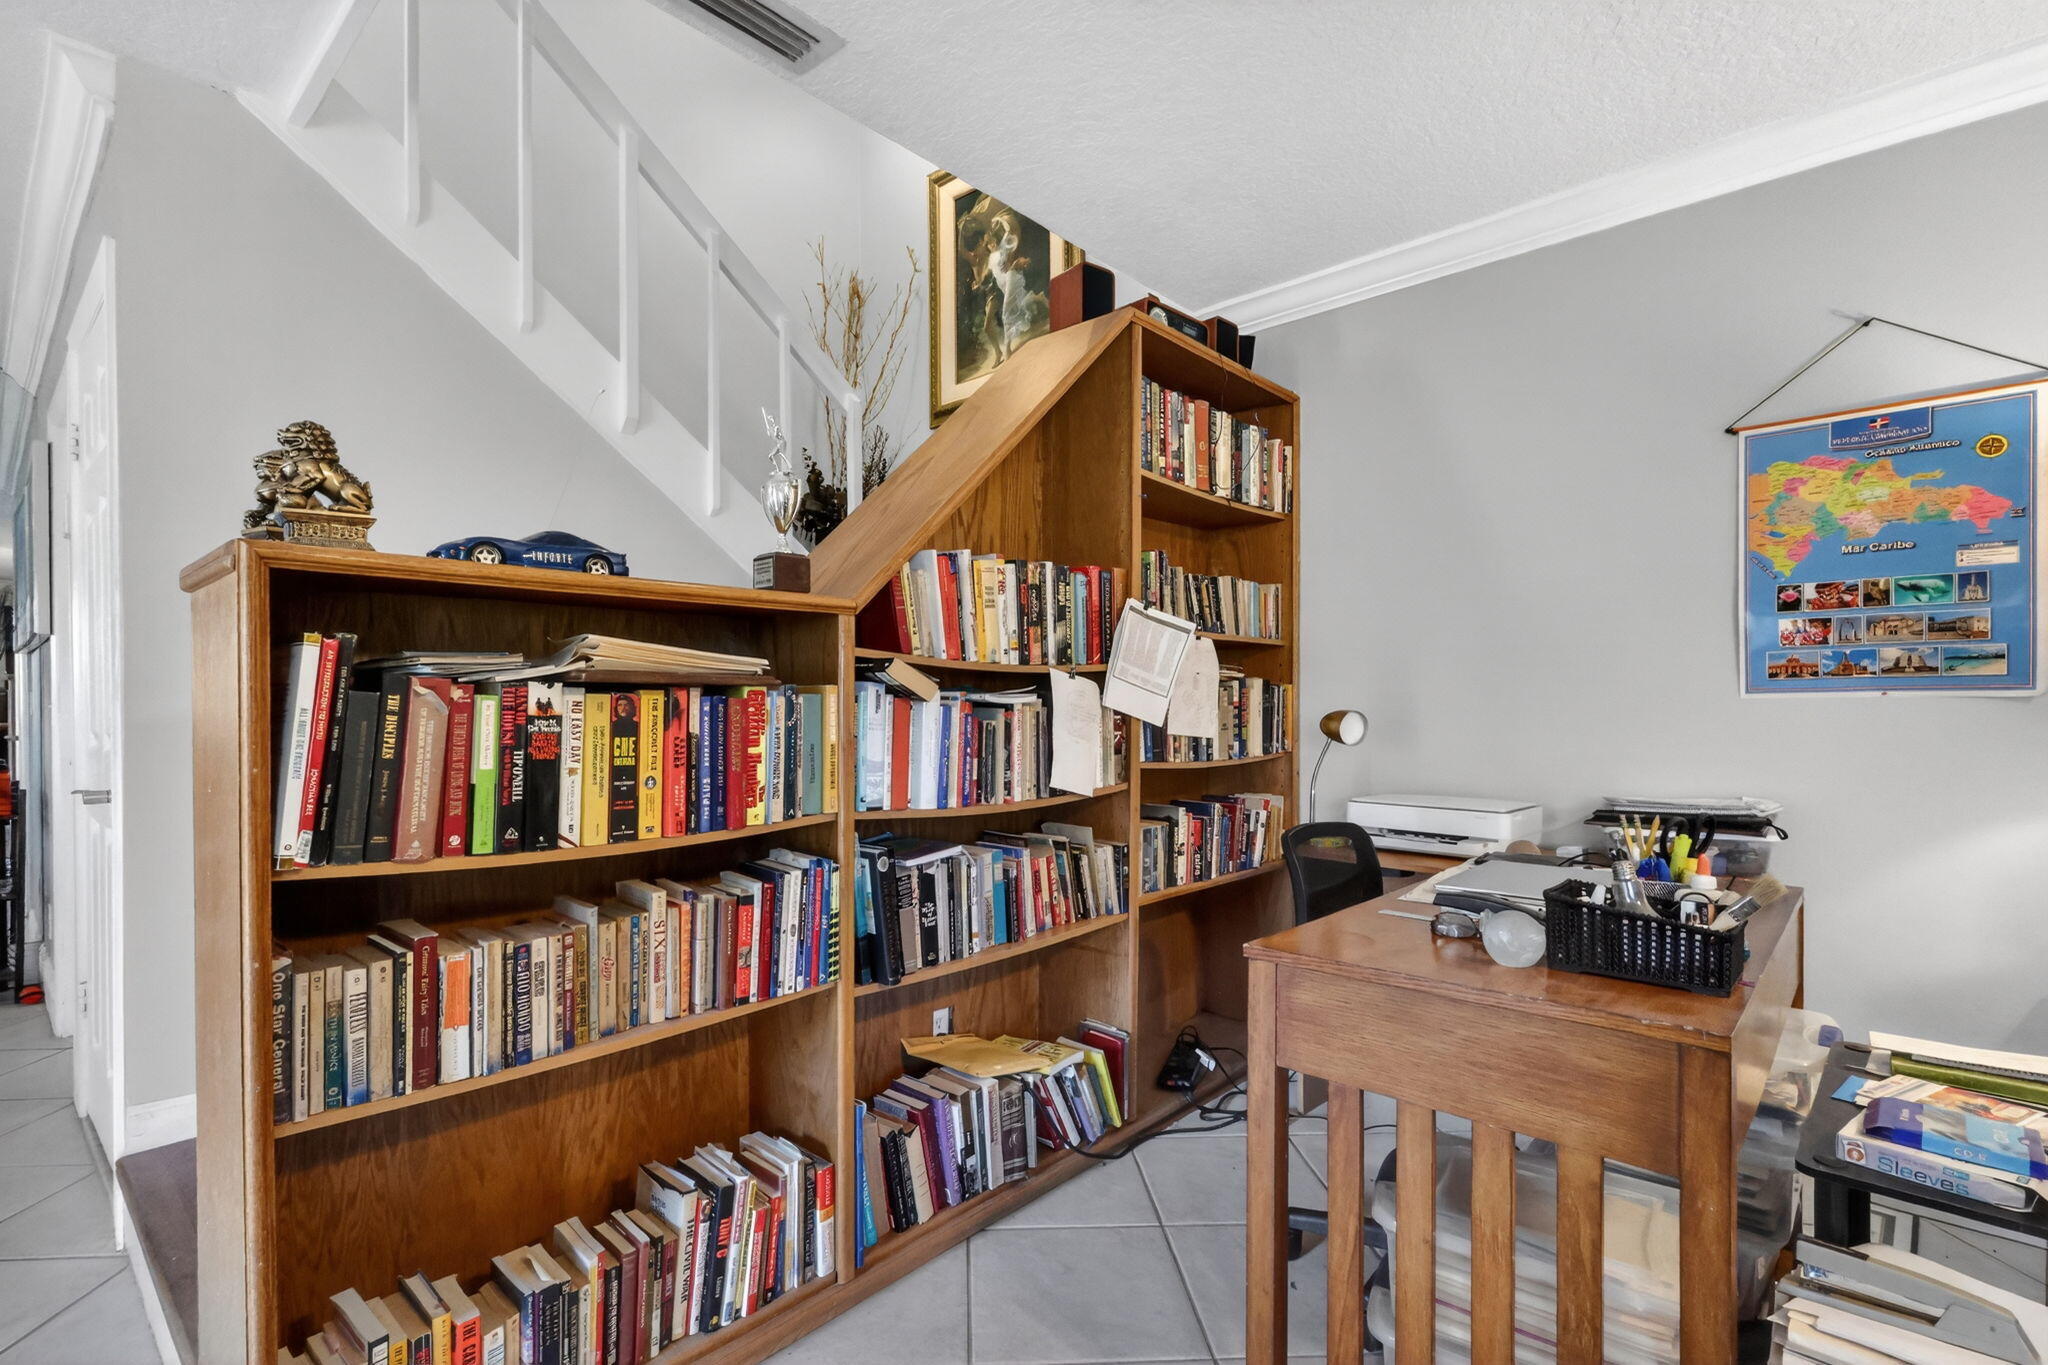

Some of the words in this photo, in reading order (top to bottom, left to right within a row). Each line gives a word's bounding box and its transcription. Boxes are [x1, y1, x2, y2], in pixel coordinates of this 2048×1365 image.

[1841, 544, 1865, 554] Mar
[1869, 541, 1915, 551] Caribe
[386, 695, 400, 712] THE
[502, 687, 515, 710] THE
[515, 687, 527, 710] MAN
[571, 701, 582, 714] NO
[500, 711, 515, 746] HOUSE
[515, 712, 527, 725] OF
[570, 718, 581, 741] EASY
[381, 715, 398, 760] DISCIPLES
[614, 737, 636, 756] CHE
[570, 746, 580, 764] DAY
[654, 920, 665, 950] SIX
[273, 972, 285, 1000] One
[273, 1004, 285, 1034] Star
[273, 1039, 286, 1094] General
[1878, 1155, 1970, 1196] Sleeves
[685, 1219, 695, 1240] THE
[718, 1216, 732, 1245] TONY
[683, 1241, 693, 1275] CIVIL
[716, 1248, 728, 1258] C
[680, 1276, 690, 1304] WAR
[463, 1320, 476, 1342] THE
